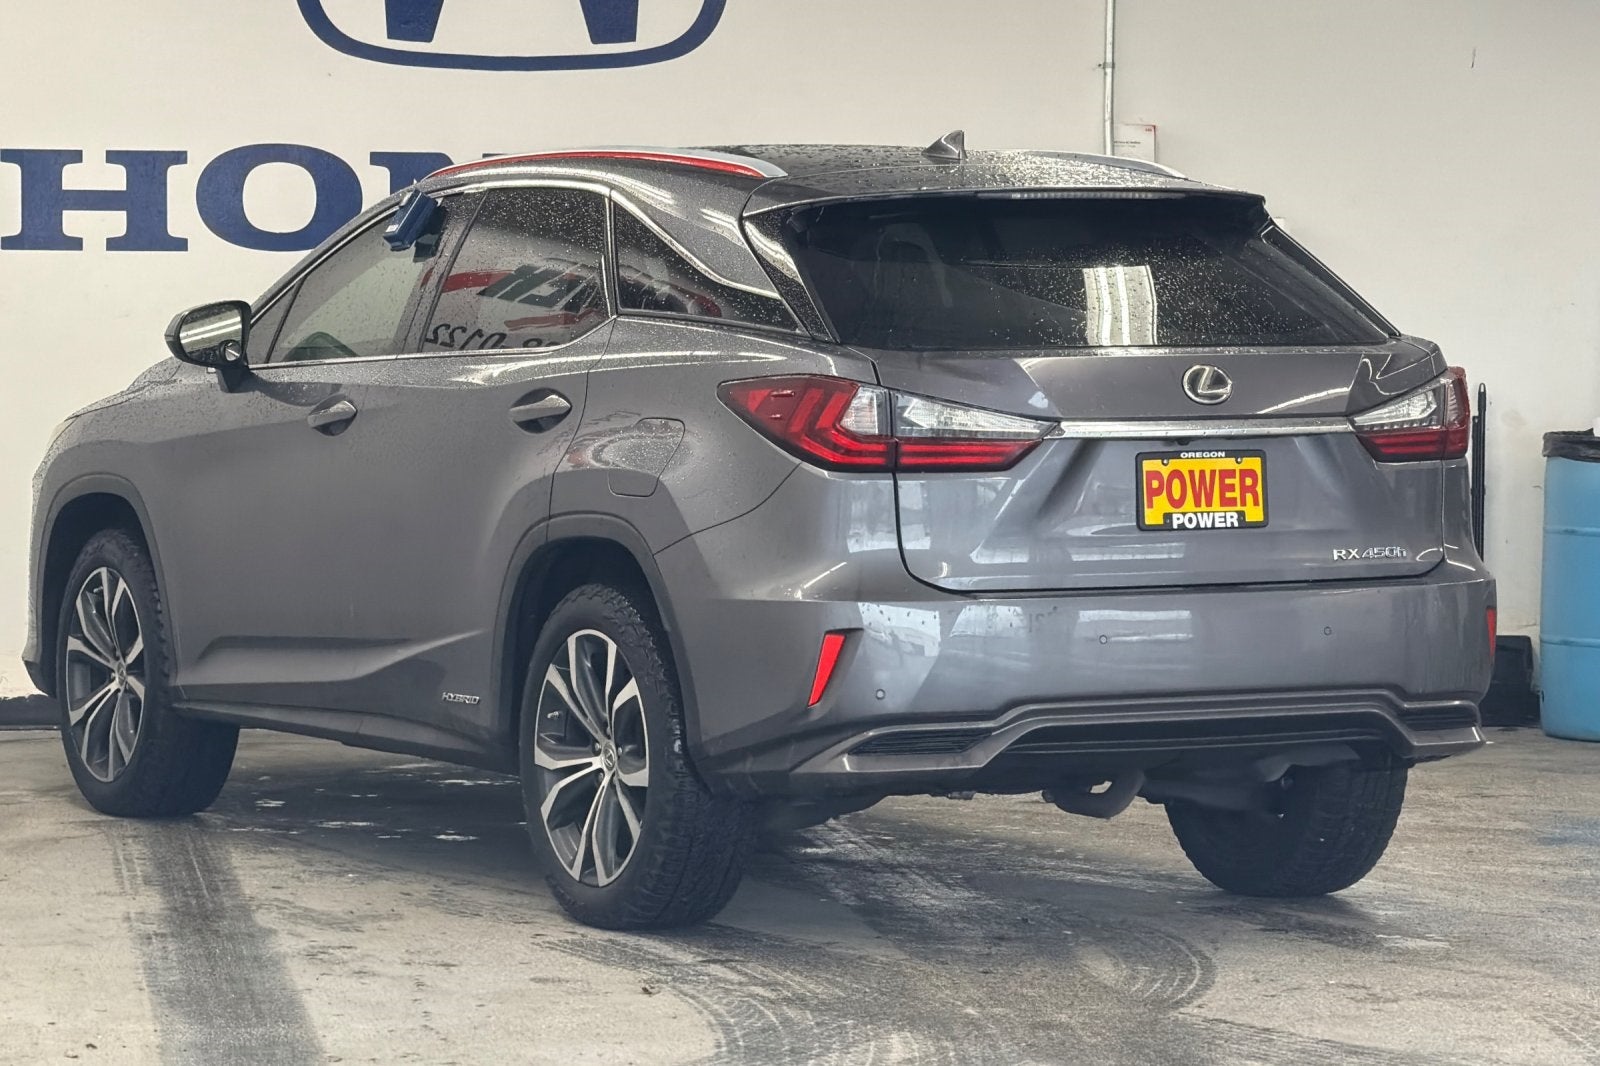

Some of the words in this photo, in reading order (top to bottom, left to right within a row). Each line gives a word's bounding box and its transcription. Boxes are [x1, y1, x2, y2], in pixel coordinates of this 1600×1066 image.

[1180, 451, 1226, 459] OREGON
[1145, 468, 1260, 509] POWER
[1172, 511, 1239, 529] POWER
[1332, 548, 1360, 561] RX
[1361, 546, 1407, 559] 450h
[441, 691, 480, 705] HYBRID
